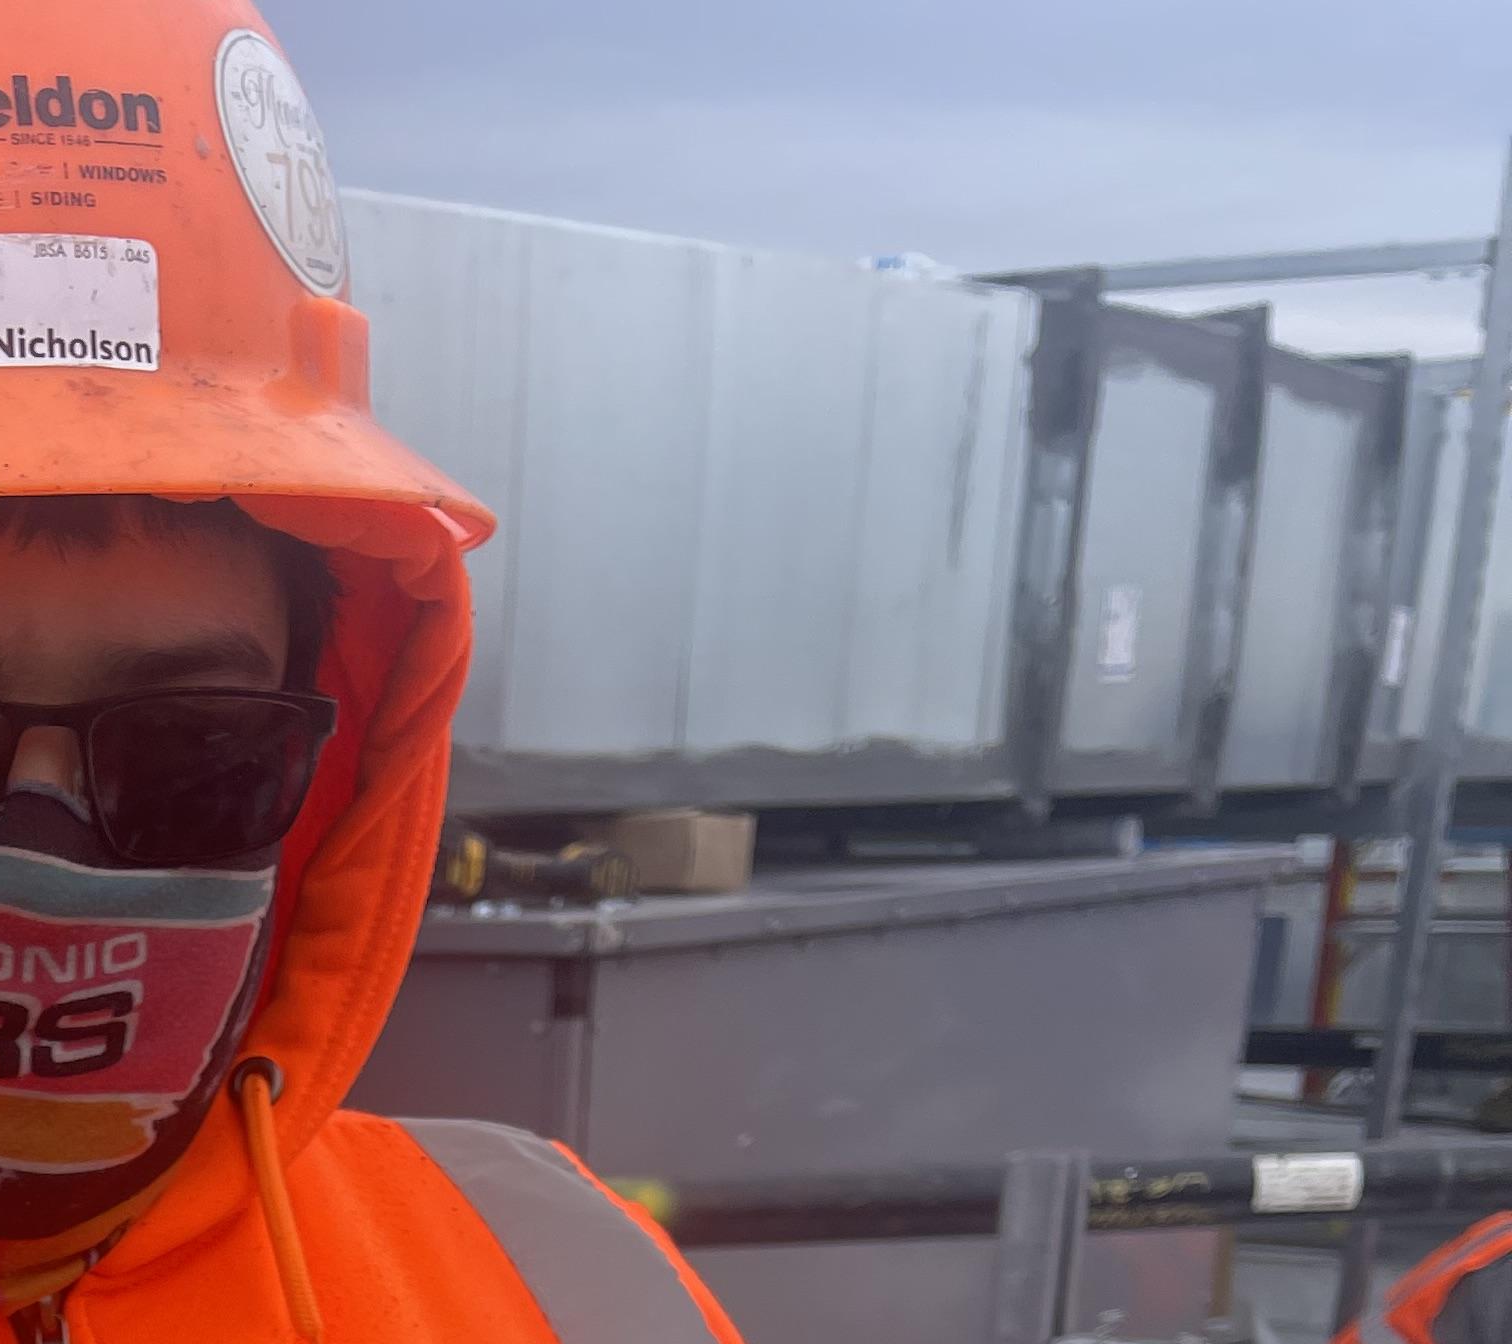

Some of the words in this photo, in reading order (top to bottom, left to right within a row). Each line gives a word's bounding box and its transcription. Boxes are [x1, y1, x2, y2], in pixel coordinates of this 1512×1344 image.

[10, 132, 56, 146] SINCE
[78, 164, 168, 185] WINDOWS
[30, 191, 97, 209] SIDING
